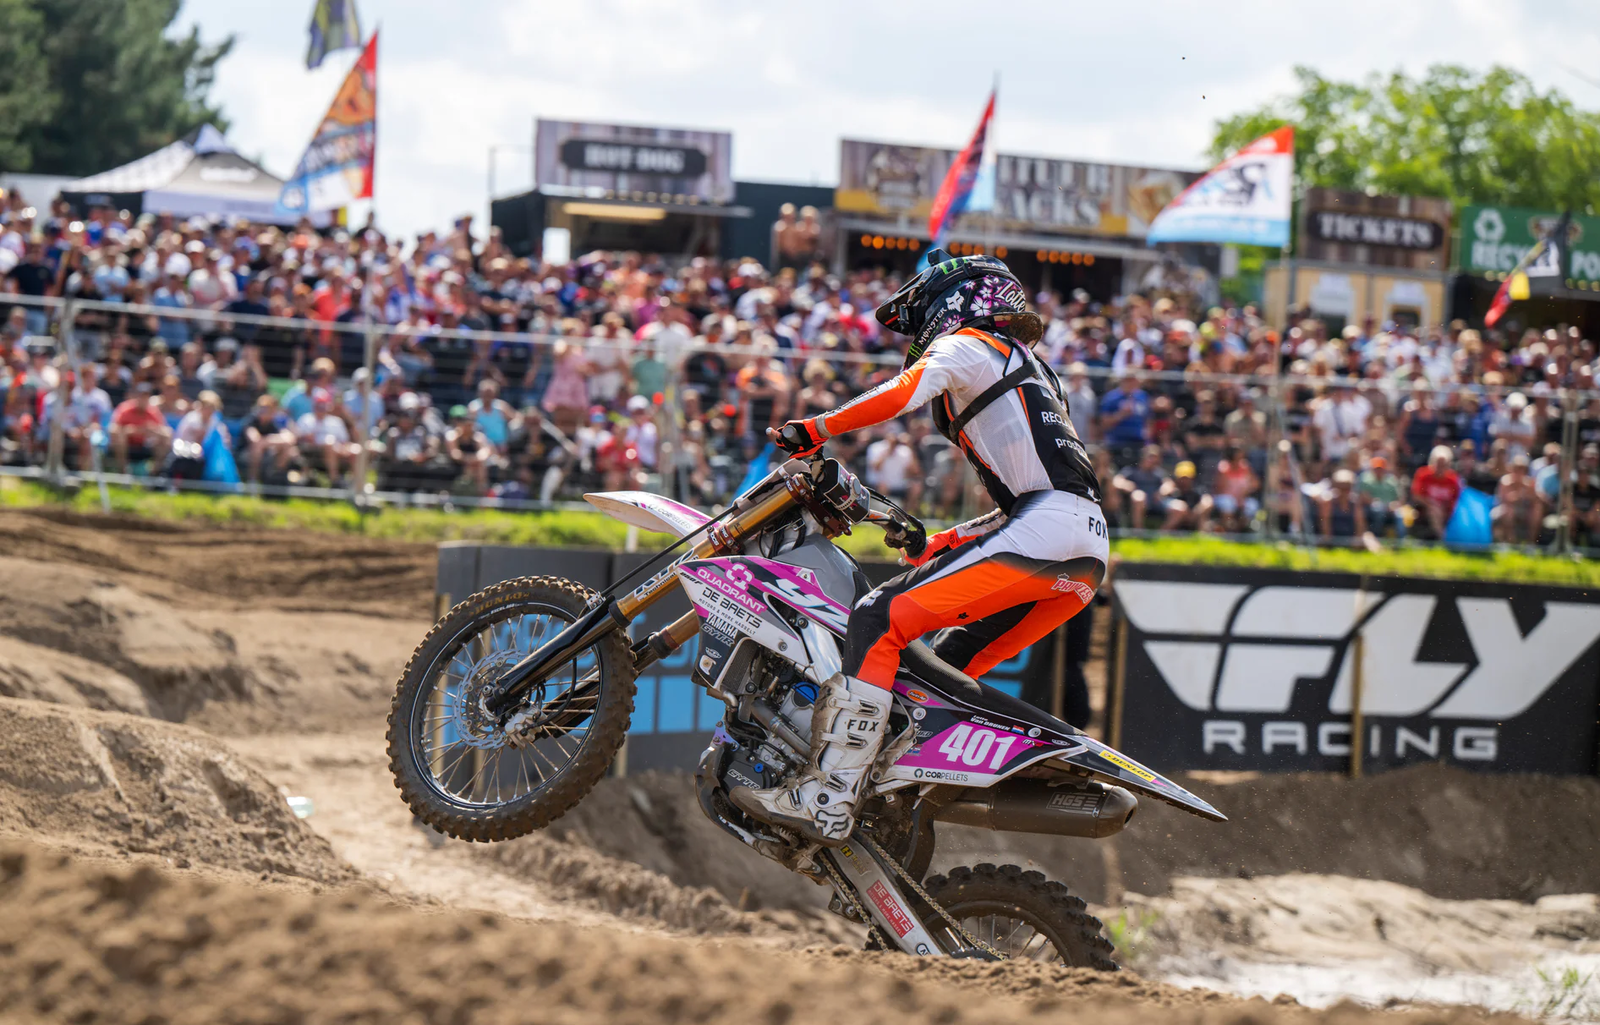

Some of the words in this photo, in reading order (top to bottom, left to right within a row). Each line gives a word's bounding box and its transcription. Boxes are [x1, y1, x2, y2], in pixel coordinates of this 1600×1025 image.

[1317, 212, 1432, 249] TICKETS
[1089, 516, 1107, 541] FOX
[697, 568, 764, 613] QUADRANT
[701, 586, 720, 603] DE
[703, 611, 740, 639] YAMAHA
[1113, 580, 1600, 719] FLY
[847, 718, 879, 732] FOX
[1201, 720, 1497, 760] RACING
[938, 723, 1017, 770] 401
[925, 771, 969, 782] CORPELLETS
